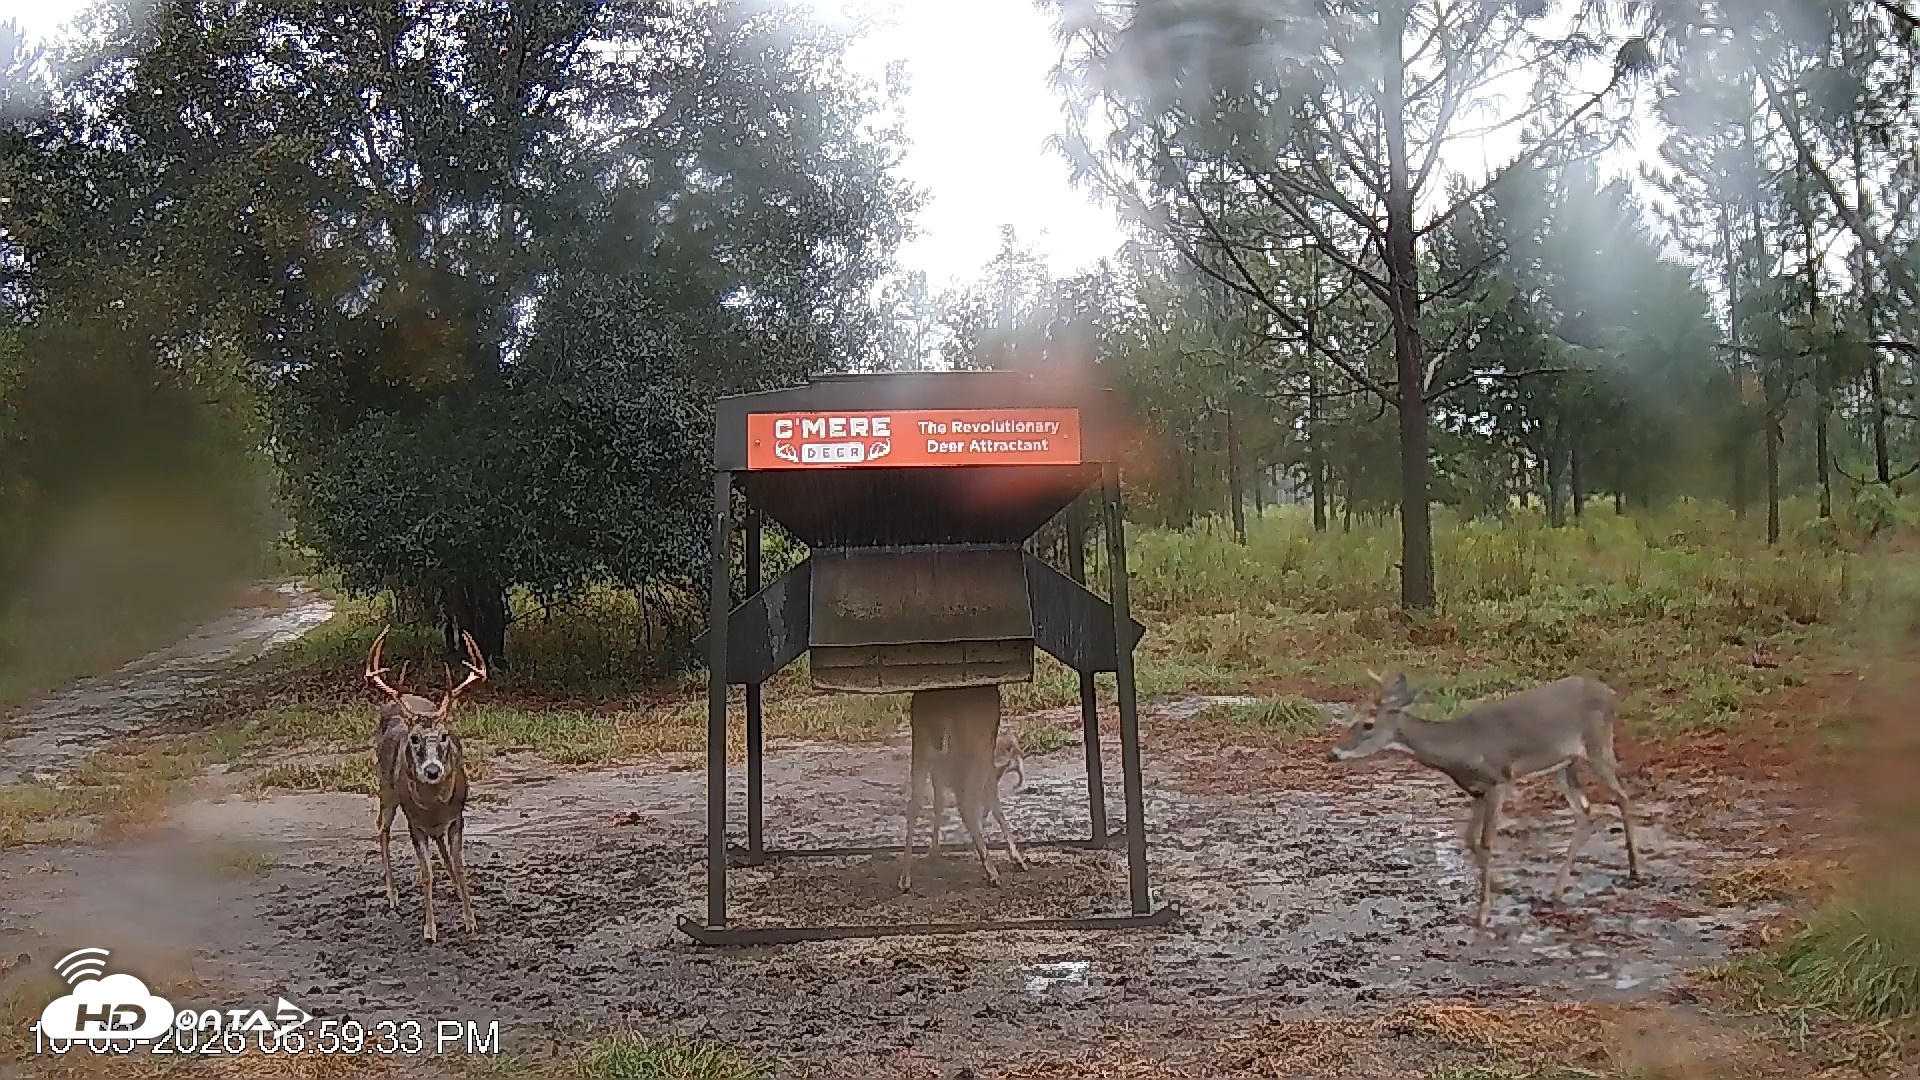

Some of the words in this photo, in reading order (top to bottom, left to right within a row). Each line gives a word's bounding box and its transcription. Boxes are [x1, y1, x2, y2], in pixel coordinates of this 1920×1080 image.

[775, 416, 891, 439] C'MERE
[917, 420, 947, 435] The
[951, 419, 1060, 435] Revolutionary
[806, 446, 860, 460] DEER
[927, 439, 965, 453] Deer
[969, 438, 1049, 453] Attractant
